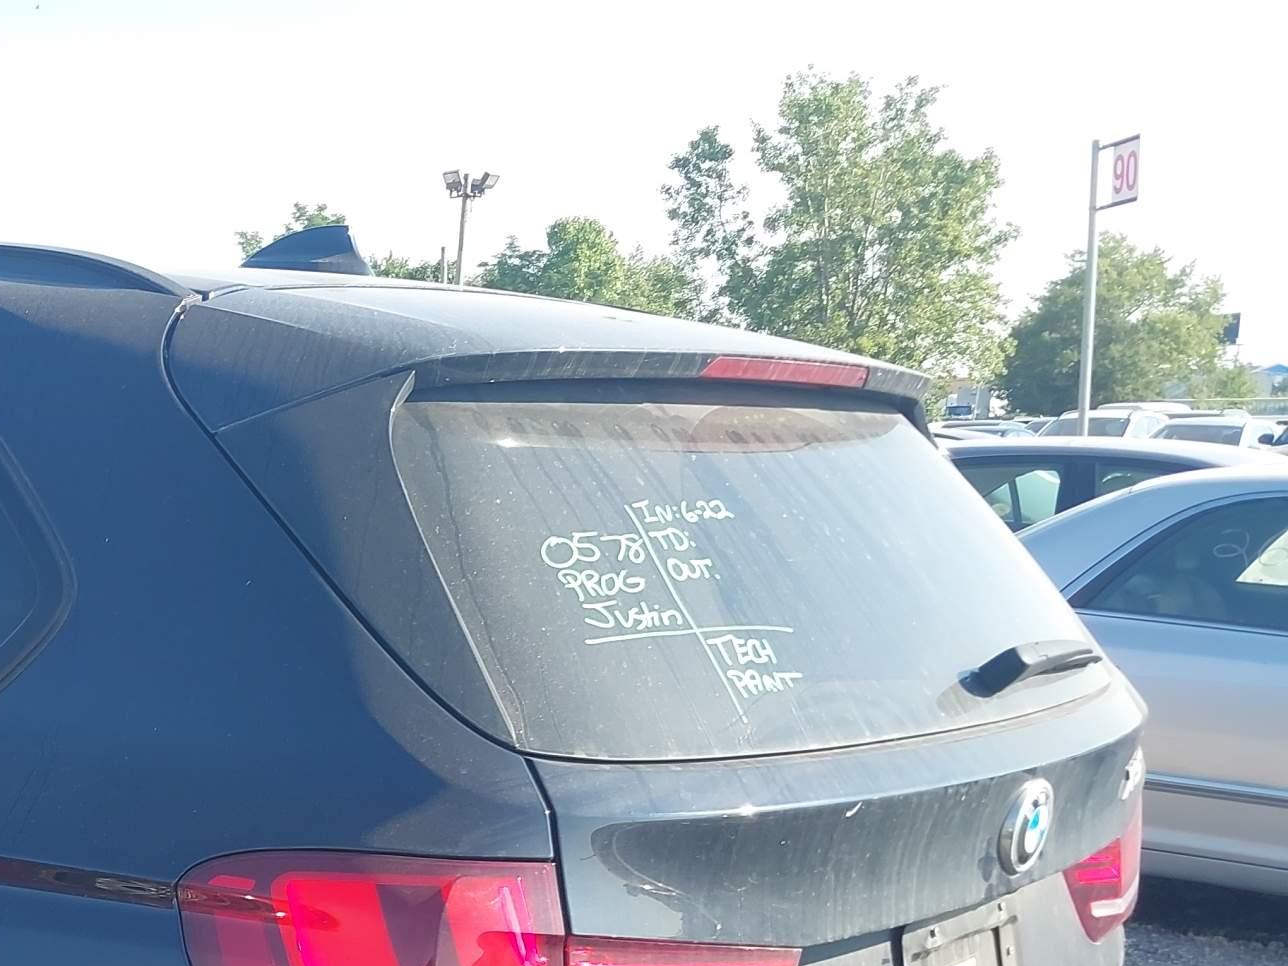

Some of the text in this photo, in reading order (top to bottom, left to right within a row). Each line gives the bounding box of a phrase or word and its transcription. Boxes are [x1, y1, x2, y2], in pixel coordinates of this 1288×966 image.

[1113, 149, 1138, 195] 90
[557, 569, 646, 602] PROG
[706, 633, 777, 666] TECH
